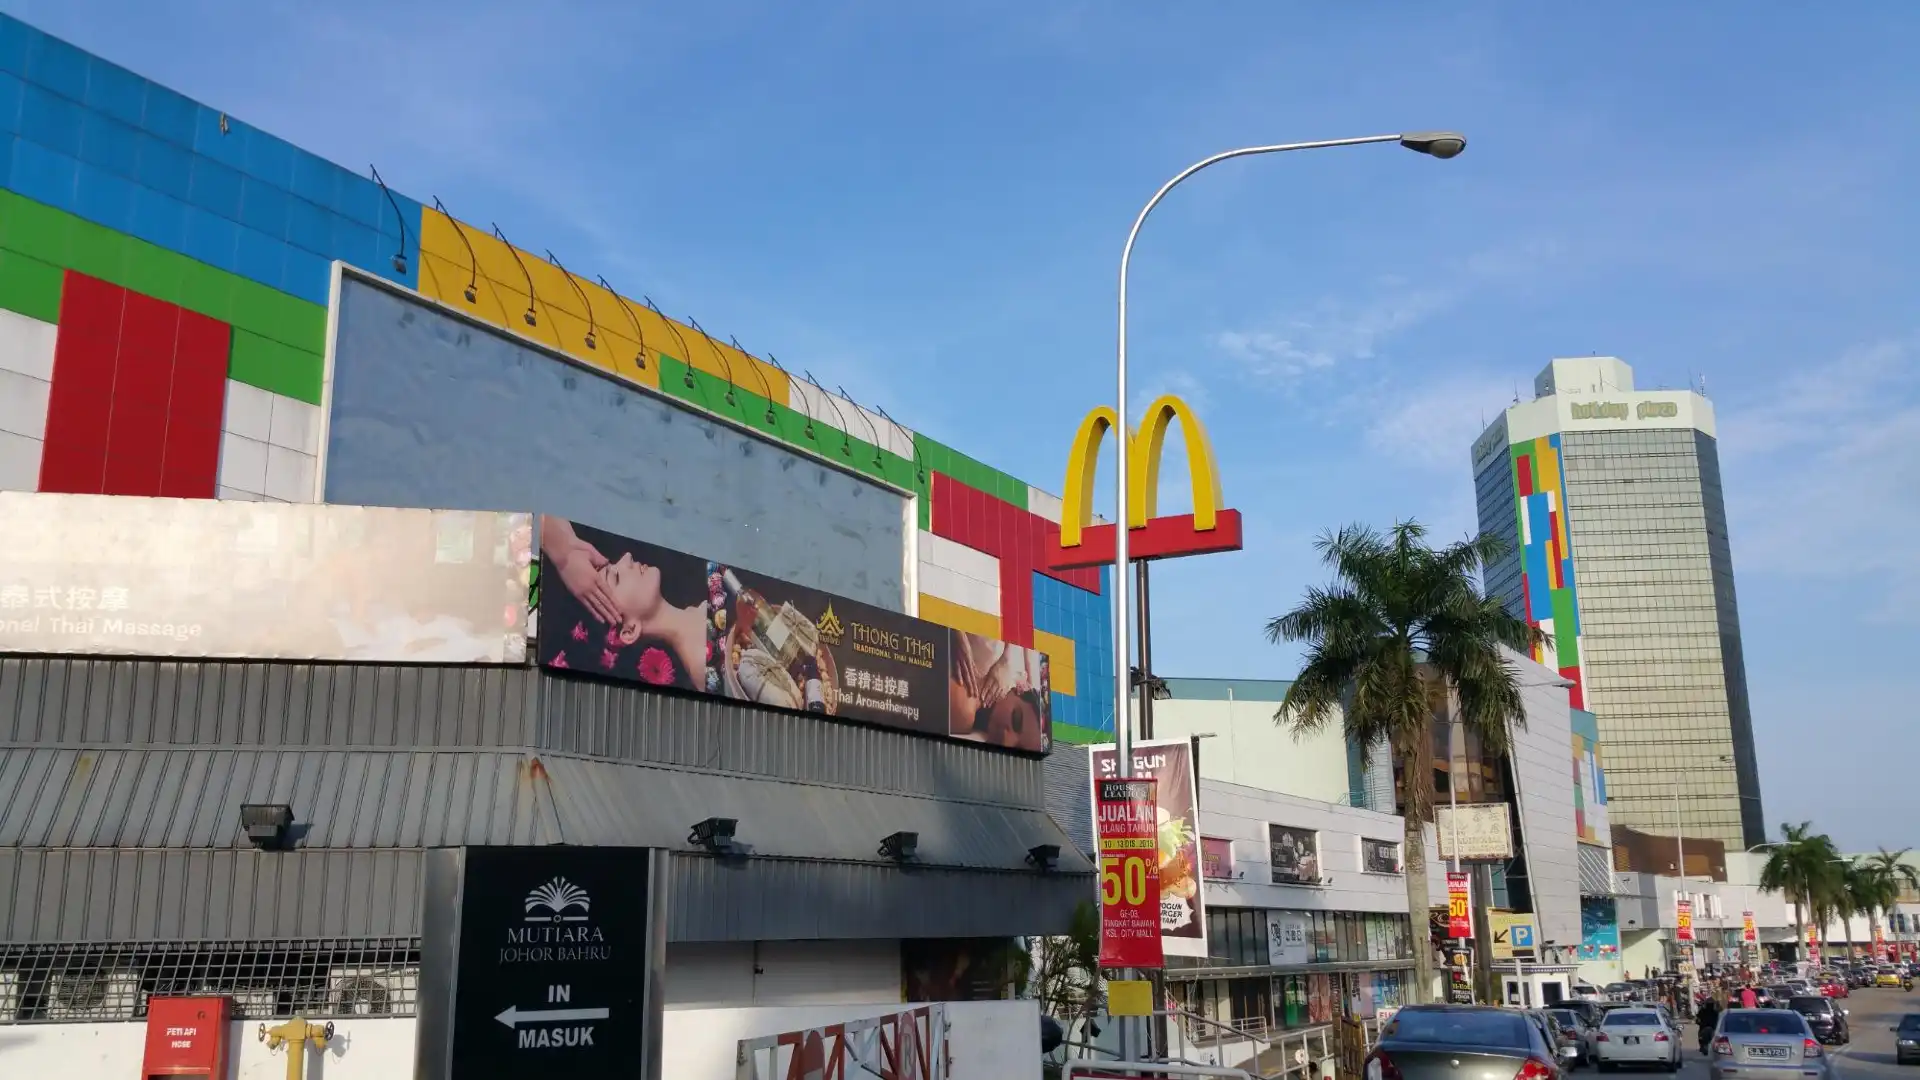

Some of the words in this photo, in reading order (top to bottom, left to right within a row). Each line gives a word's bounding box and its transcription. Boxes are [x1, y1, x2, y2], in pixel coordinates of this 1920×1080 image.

[50, 615, 94, 635] Thai
[102, 618, 202, 641] Massage
[851, 622, 900, 651] THONG
[904, 636, 935, 660] THAI
[853, 642, 892, 659] TRADITIONAL
[845, 667, 910, 699] 香精油按摩
[833, 688, 854, 705] Thai
[856, 693, 919, 720] Aromatherapy
[1099, 804, 1154, 823] JUALAN
[1160, 902, 1183, 911] OGUN
[508, 926, 604, 944] MUTIARA
[1121, 928, 1135, 938] CITY
[1515, 927, 1528, 945] P
[500, 947, 553, 964] JOHOR
[558, 945, 611, 961] BAHRU
[548, 984, 570, 1003] IN
[518, 1026, 595, 1049] MASUK
